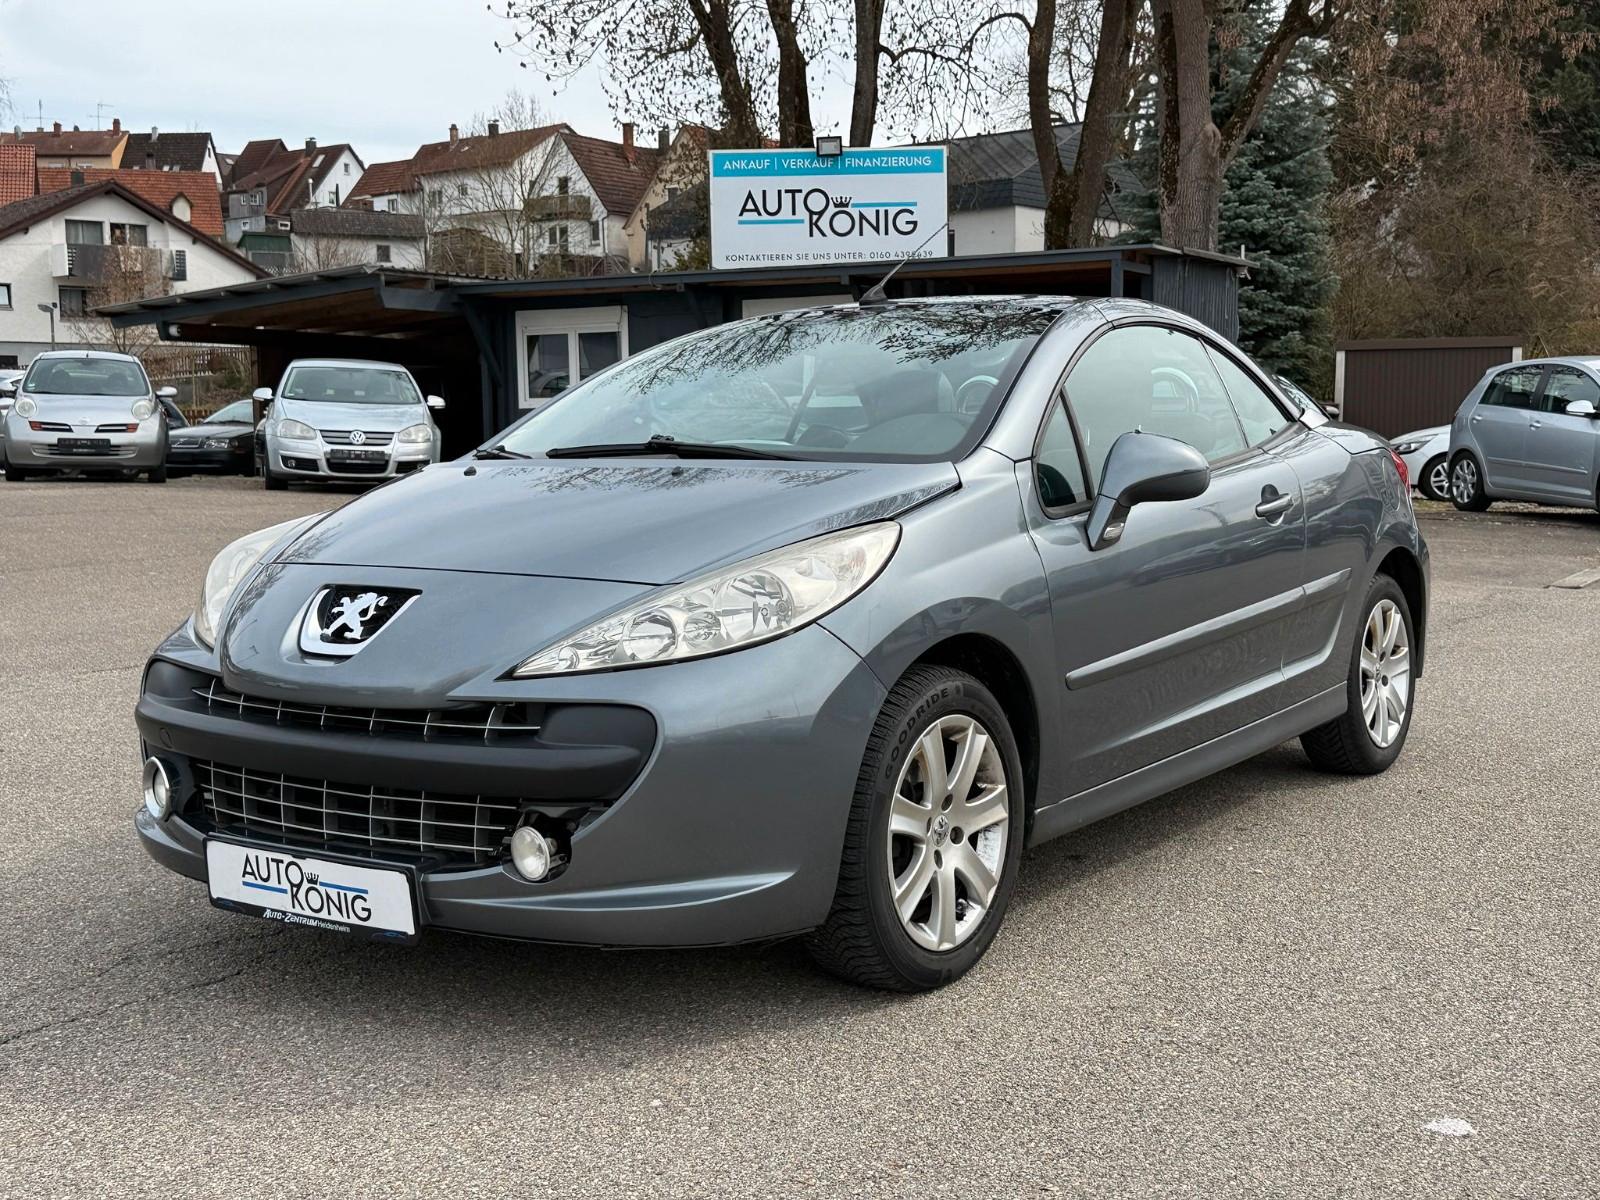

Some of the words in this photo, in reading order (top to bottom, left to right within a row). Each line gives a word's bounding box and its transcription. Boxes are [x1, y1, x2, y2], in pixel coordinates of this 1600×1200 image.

[723, 159, 771, 170] ANKAUF
[781, 157, 834, 169] VERKAUF
[845, 156, 932, 168] FINANZIERUNG
[738, 188, 830, 217] AUTO
[725, 252, 793, 262] KONTAKTIEREN
[796, 252, 810, 261] SIE
[812, 252, 831, 260] UNS
[834, 251, 867, 260] UNTER:
[869, 251, 891, 259] 0160
[885, 688, 949, 778] GOODRIDE
[241, 853, 304, 886] AUTO
[317, 921, 351, 933] Heidenheim
